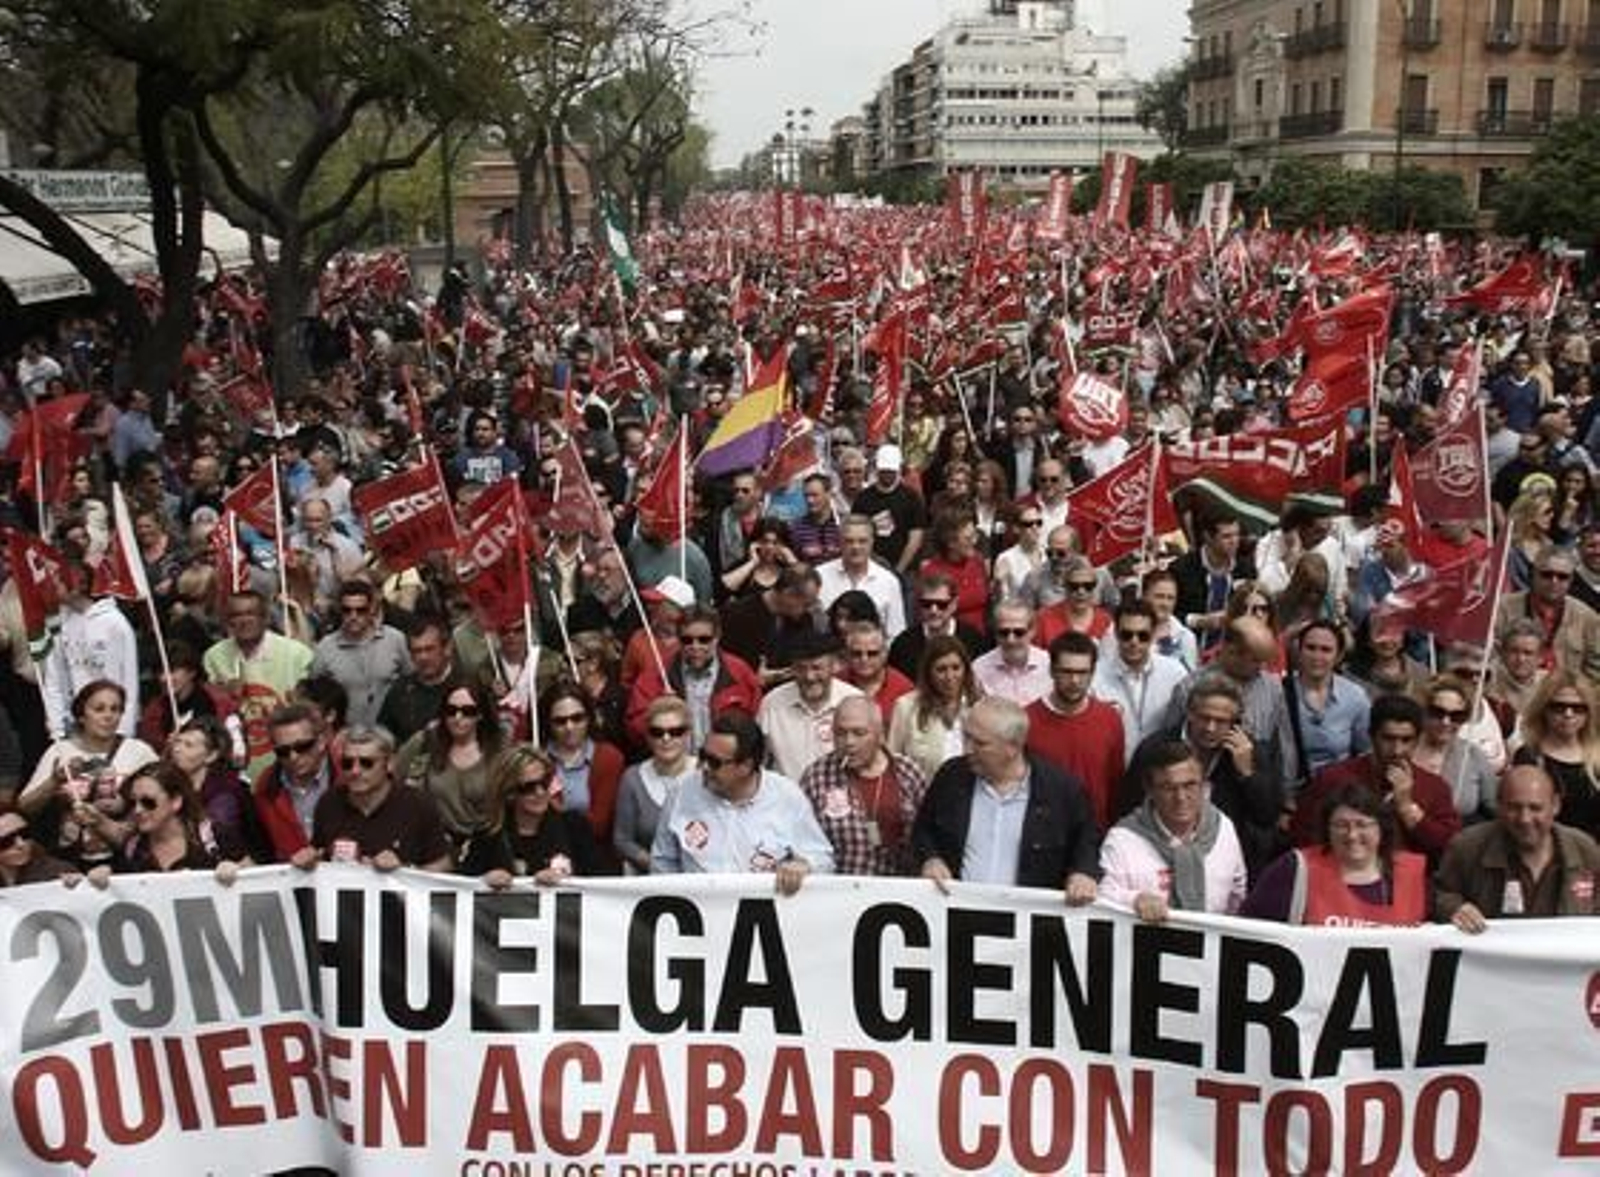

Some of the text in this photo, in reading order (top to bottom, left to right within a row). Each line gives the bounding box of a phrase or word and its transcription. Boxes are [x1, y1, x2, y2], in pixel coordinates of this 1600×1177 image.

[1071, 372, 1122, 416] UGT
[10, 886, 1488, 1080] 29M HUELGA GENERAL
[13, 1021, 427, 1170] QUIEREN
[466, 1041, 896, 1162] ACABAR
[938, 1053, 1155, 1177] CON
[1196, 1074, 1482, 1177] TODO
